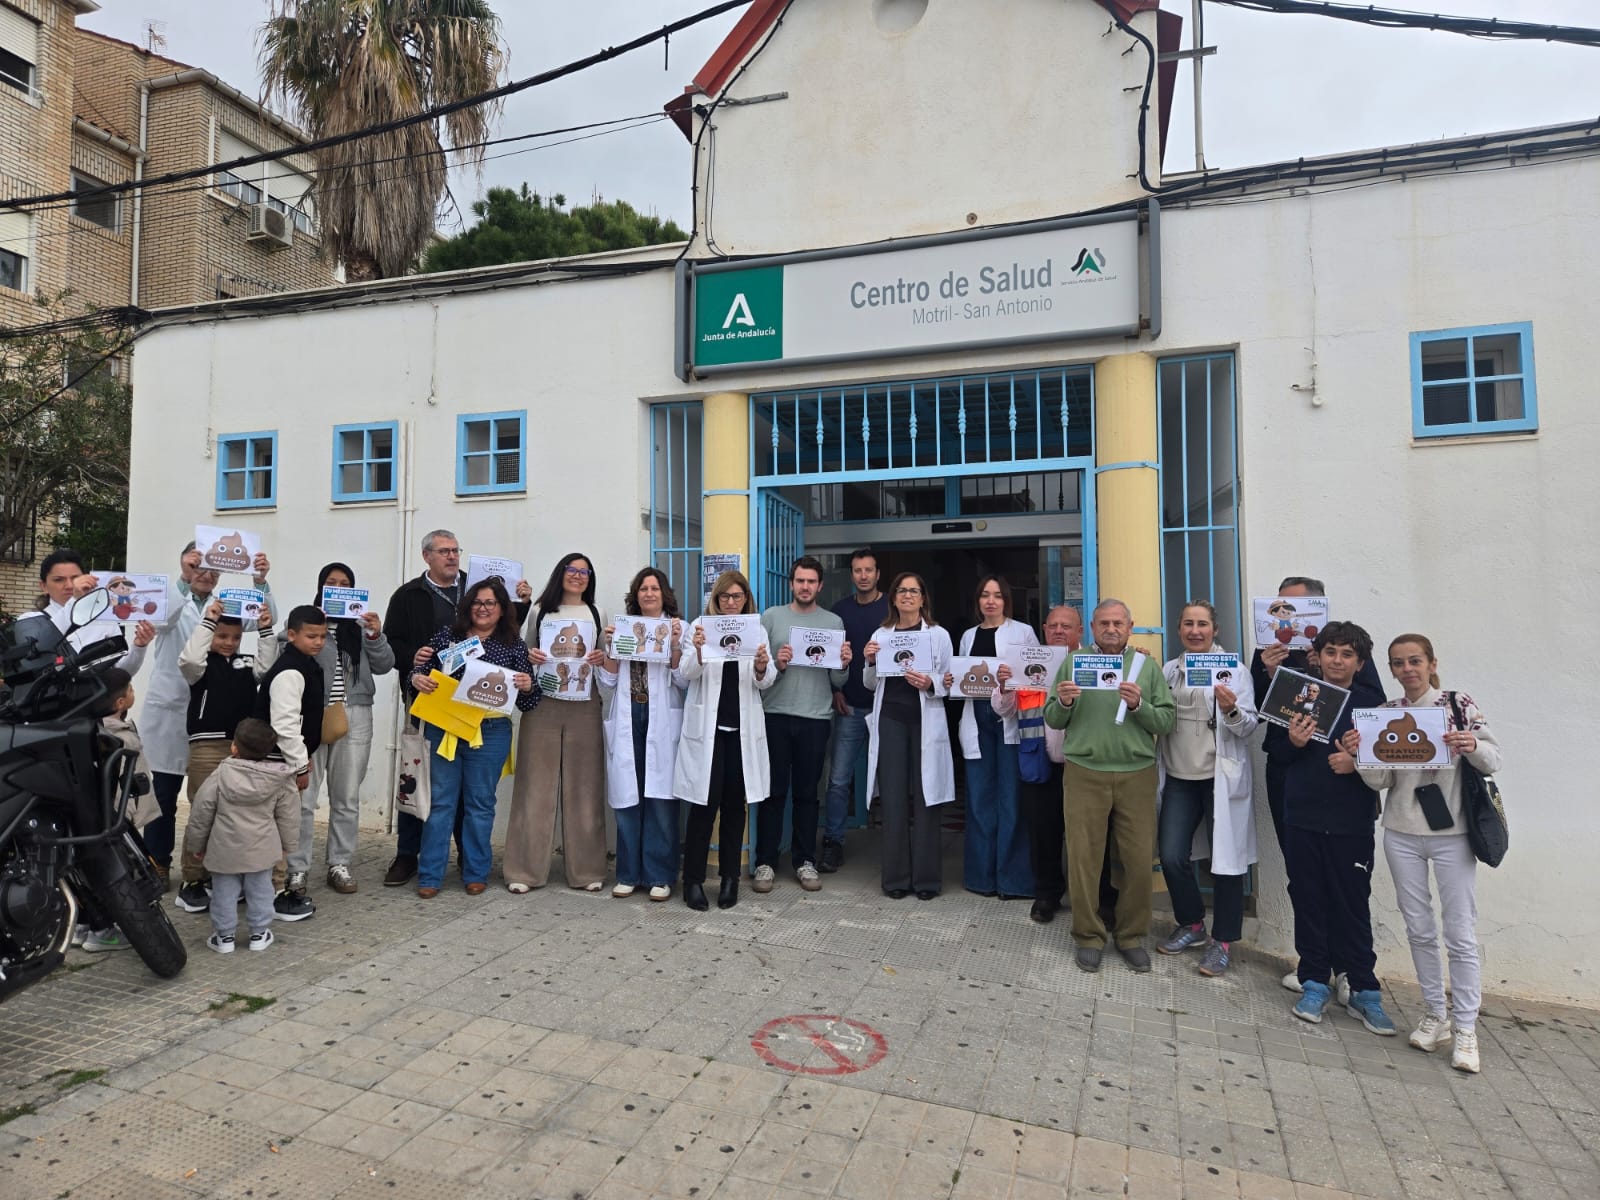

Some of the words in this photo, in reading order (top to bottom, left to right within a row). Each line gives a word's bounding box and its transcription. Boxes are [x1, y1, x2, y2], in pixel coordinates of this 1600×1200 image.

[850, 278, 930, 309] Centro
[939, 270, 969, 299] de
[979, 258, 1053, 295] Salud
[963, 302, 991, 320] San
[996, 295, 1054, 316] Antonio
[702, 332, 725, 342] Junta
[726, 330, 736, 340] de
[737, 326, 776, 338] Andalucía
